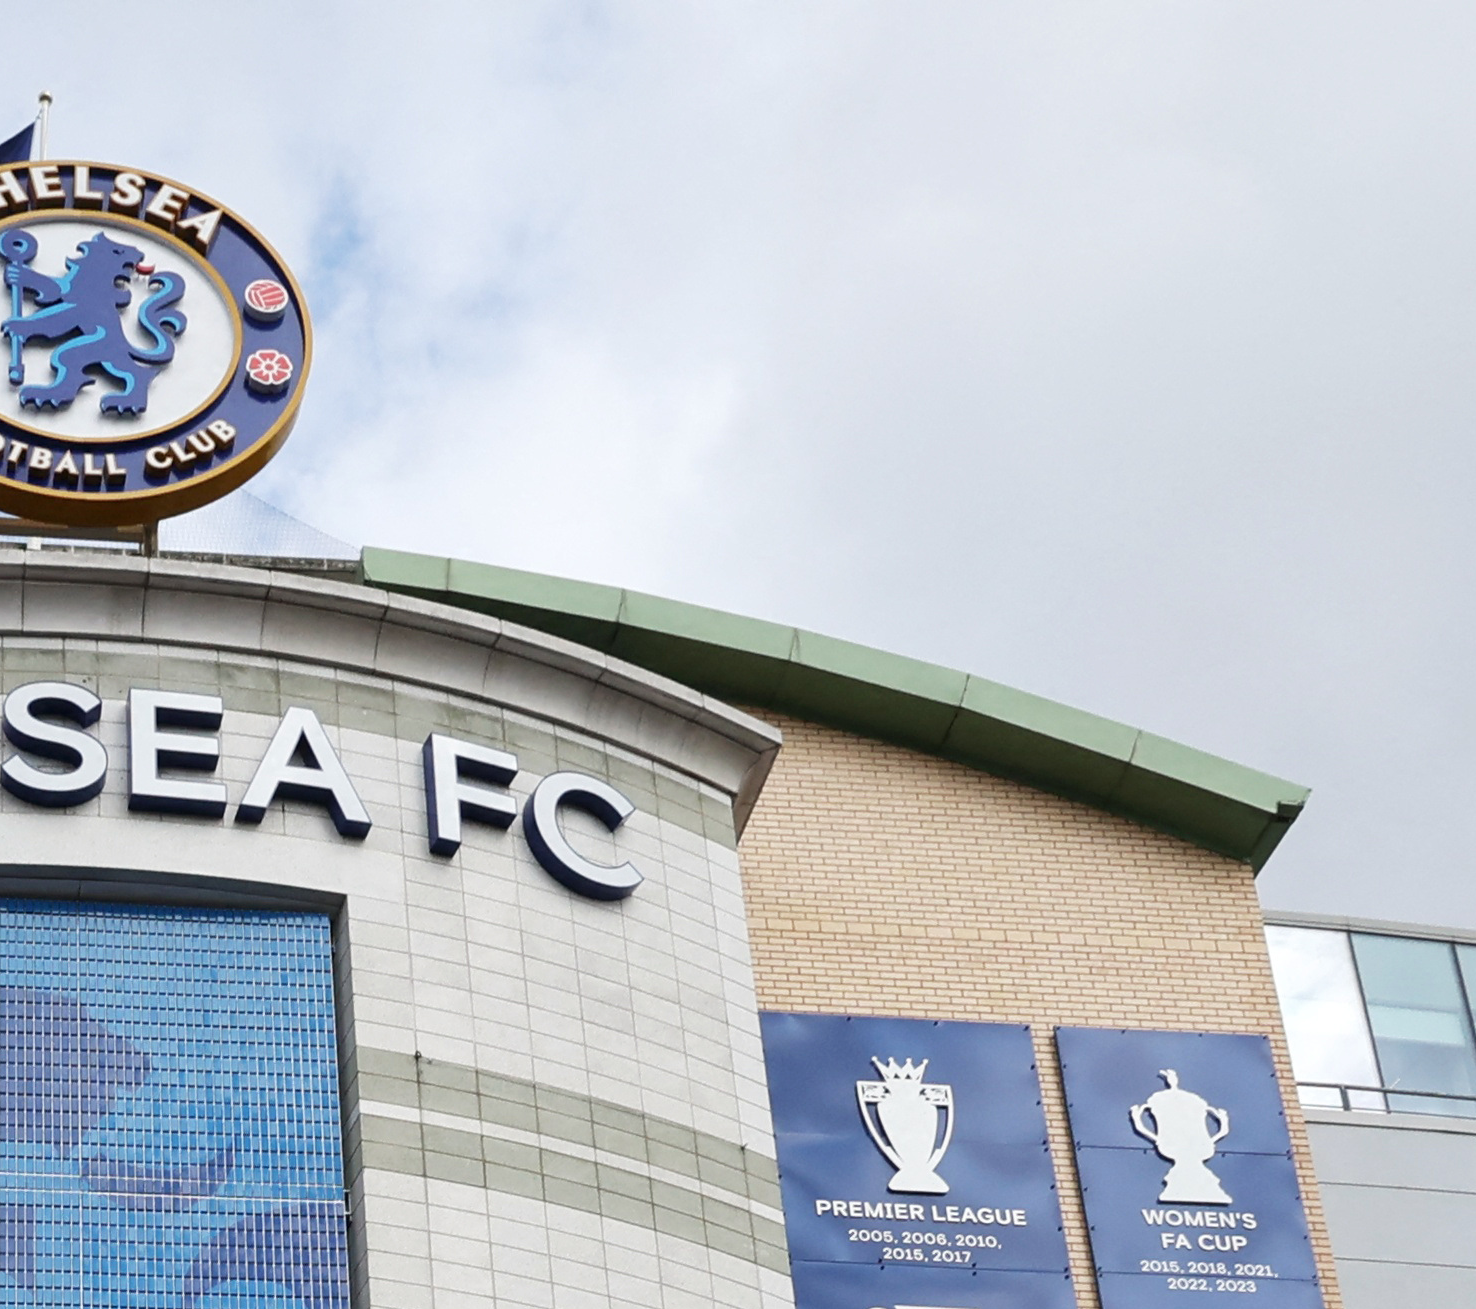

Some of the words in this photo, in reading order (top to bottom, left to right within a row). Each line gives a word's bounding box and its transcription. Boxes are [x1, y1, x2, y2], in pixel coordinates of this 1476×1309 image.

[145, 419, 238, 473] CLUB
[423, 732, 648, 902] FC
[815, 1199, 925, 1221] PREMIER
[931, 1205, 1027, 1226] LEAGUE
[1141, 1208, 1257, 1229] WOMEN'S
[848, 1228, 899, 1244] 2005,
[901, 1231, 952, 1247] 2006,
[954, 1233, 1002, 1250] 2010,
[1161, 1232, 1193, 1250] FA
[1197, 1234, 1248, 1251] CUP
[882, 1246, 929, 1263] 2015,
[931, 1249, 972, 1263] 2017
[1139, 1259, 1185, 1274] 2015,
[1187, 1261, 1232, 1276] 2018,
[1234, 1263, 1279, 1278] 2021,
[1166, 1277, 1213, 1292] 2022,
[1215, 1279, 1257, 1293] 2023
